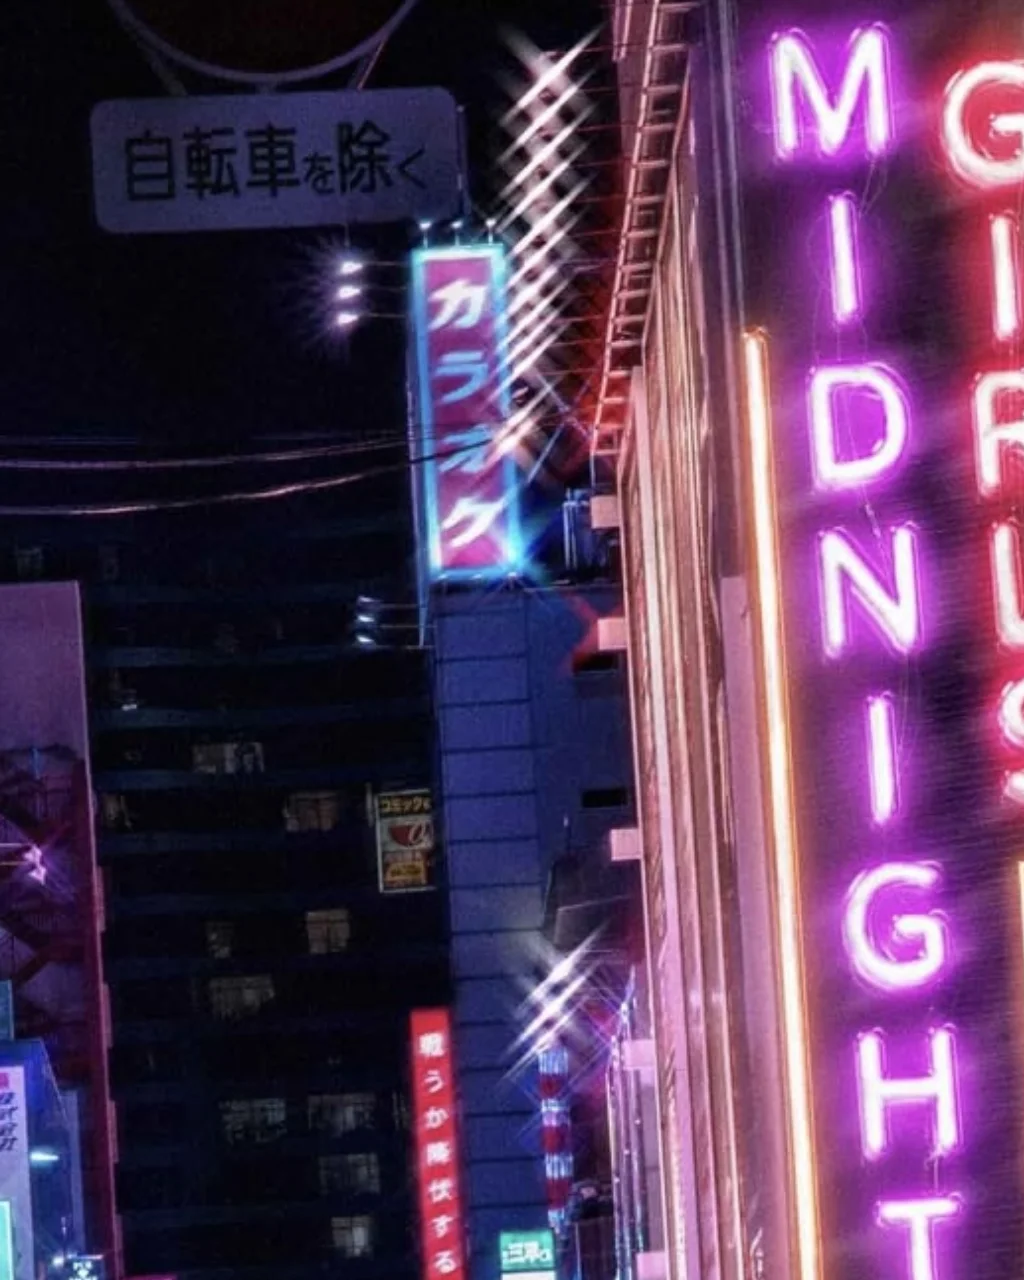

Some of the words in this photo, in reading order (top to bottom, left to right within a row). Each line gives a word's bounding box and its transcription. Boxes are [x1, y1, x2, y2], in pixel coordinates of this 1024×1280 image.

[124, 122, 427, 201] 自転車を除く
[430, 278, 501, 548] カラオケ
